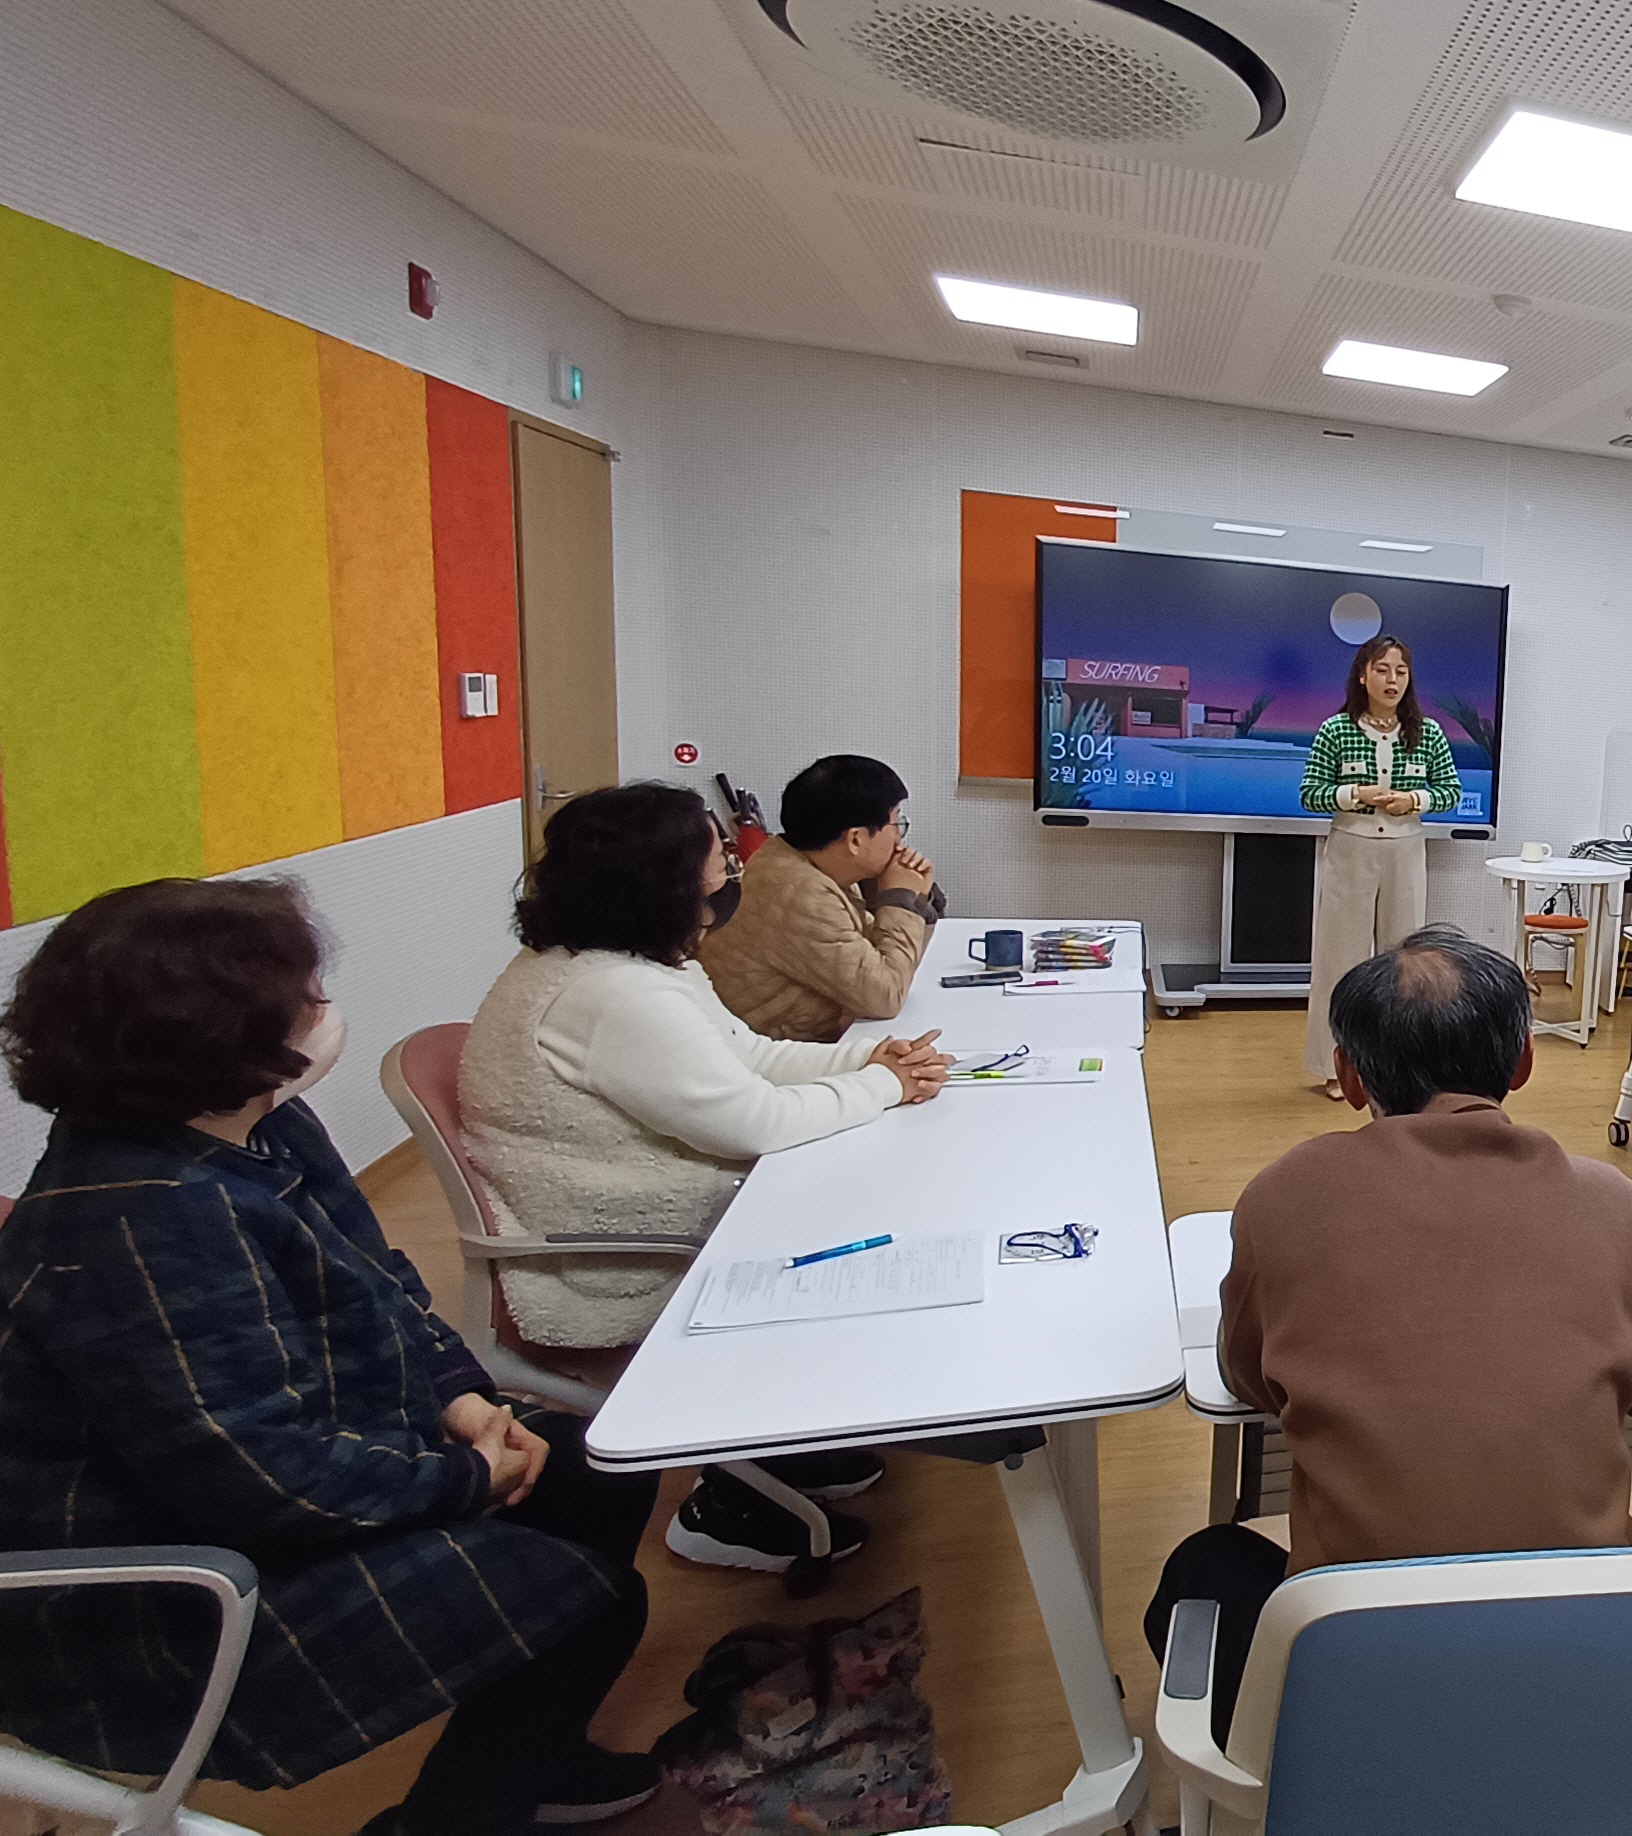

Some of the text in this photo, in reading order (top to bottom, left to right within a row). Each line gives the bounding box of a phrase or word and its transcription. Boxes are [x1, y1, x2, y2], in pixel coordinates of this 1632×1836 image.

[1080, 661, 1161, 683] SURFING
[1050, 732, 1115, 761] 3:04
[1050, 766, 1174, 788] 2월 20일 화요일
